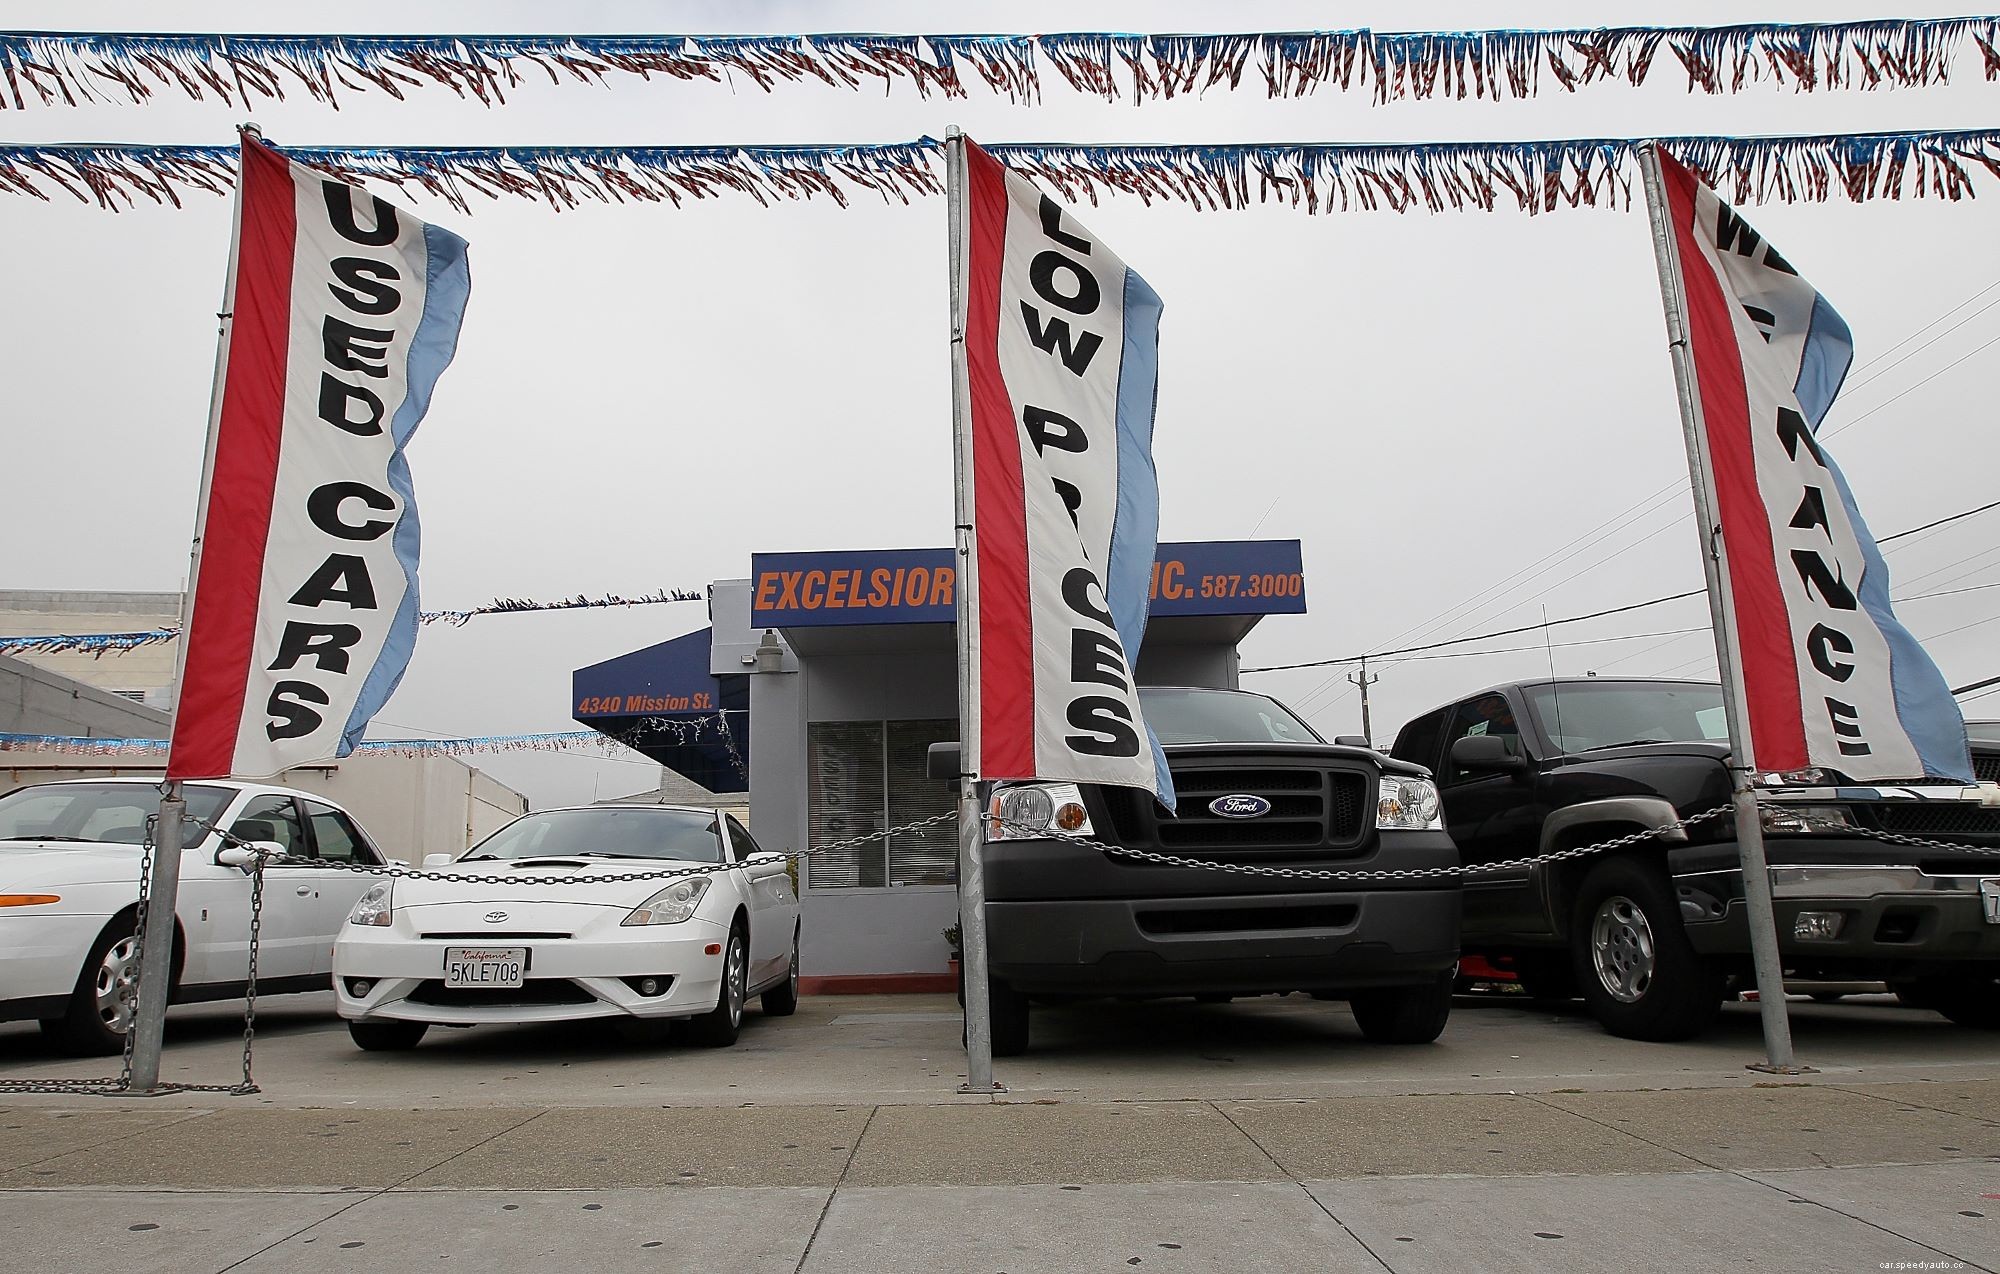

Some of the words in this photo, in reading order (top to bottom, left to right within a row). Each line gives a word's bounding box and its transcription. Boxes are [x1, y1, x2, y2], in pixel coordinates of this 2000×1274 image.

[1019, 192, 1103, 377] LOW
[318, 179, 402, 437] USED
[754, 567, 956, 611] EXCELSIOR
[1201, 573, 1301, 599] 587.3000
[265, 481, 396, 743] CARS
[578, 696, 622, 714] 4340
[624, 693, 689, 712] Mission
[692, 692, 713, 710] St.
[1224, 798, 1258, 812] Ford
[451, 962, 519, 982] 5KLE708
[463, 950, 511, 962] California
